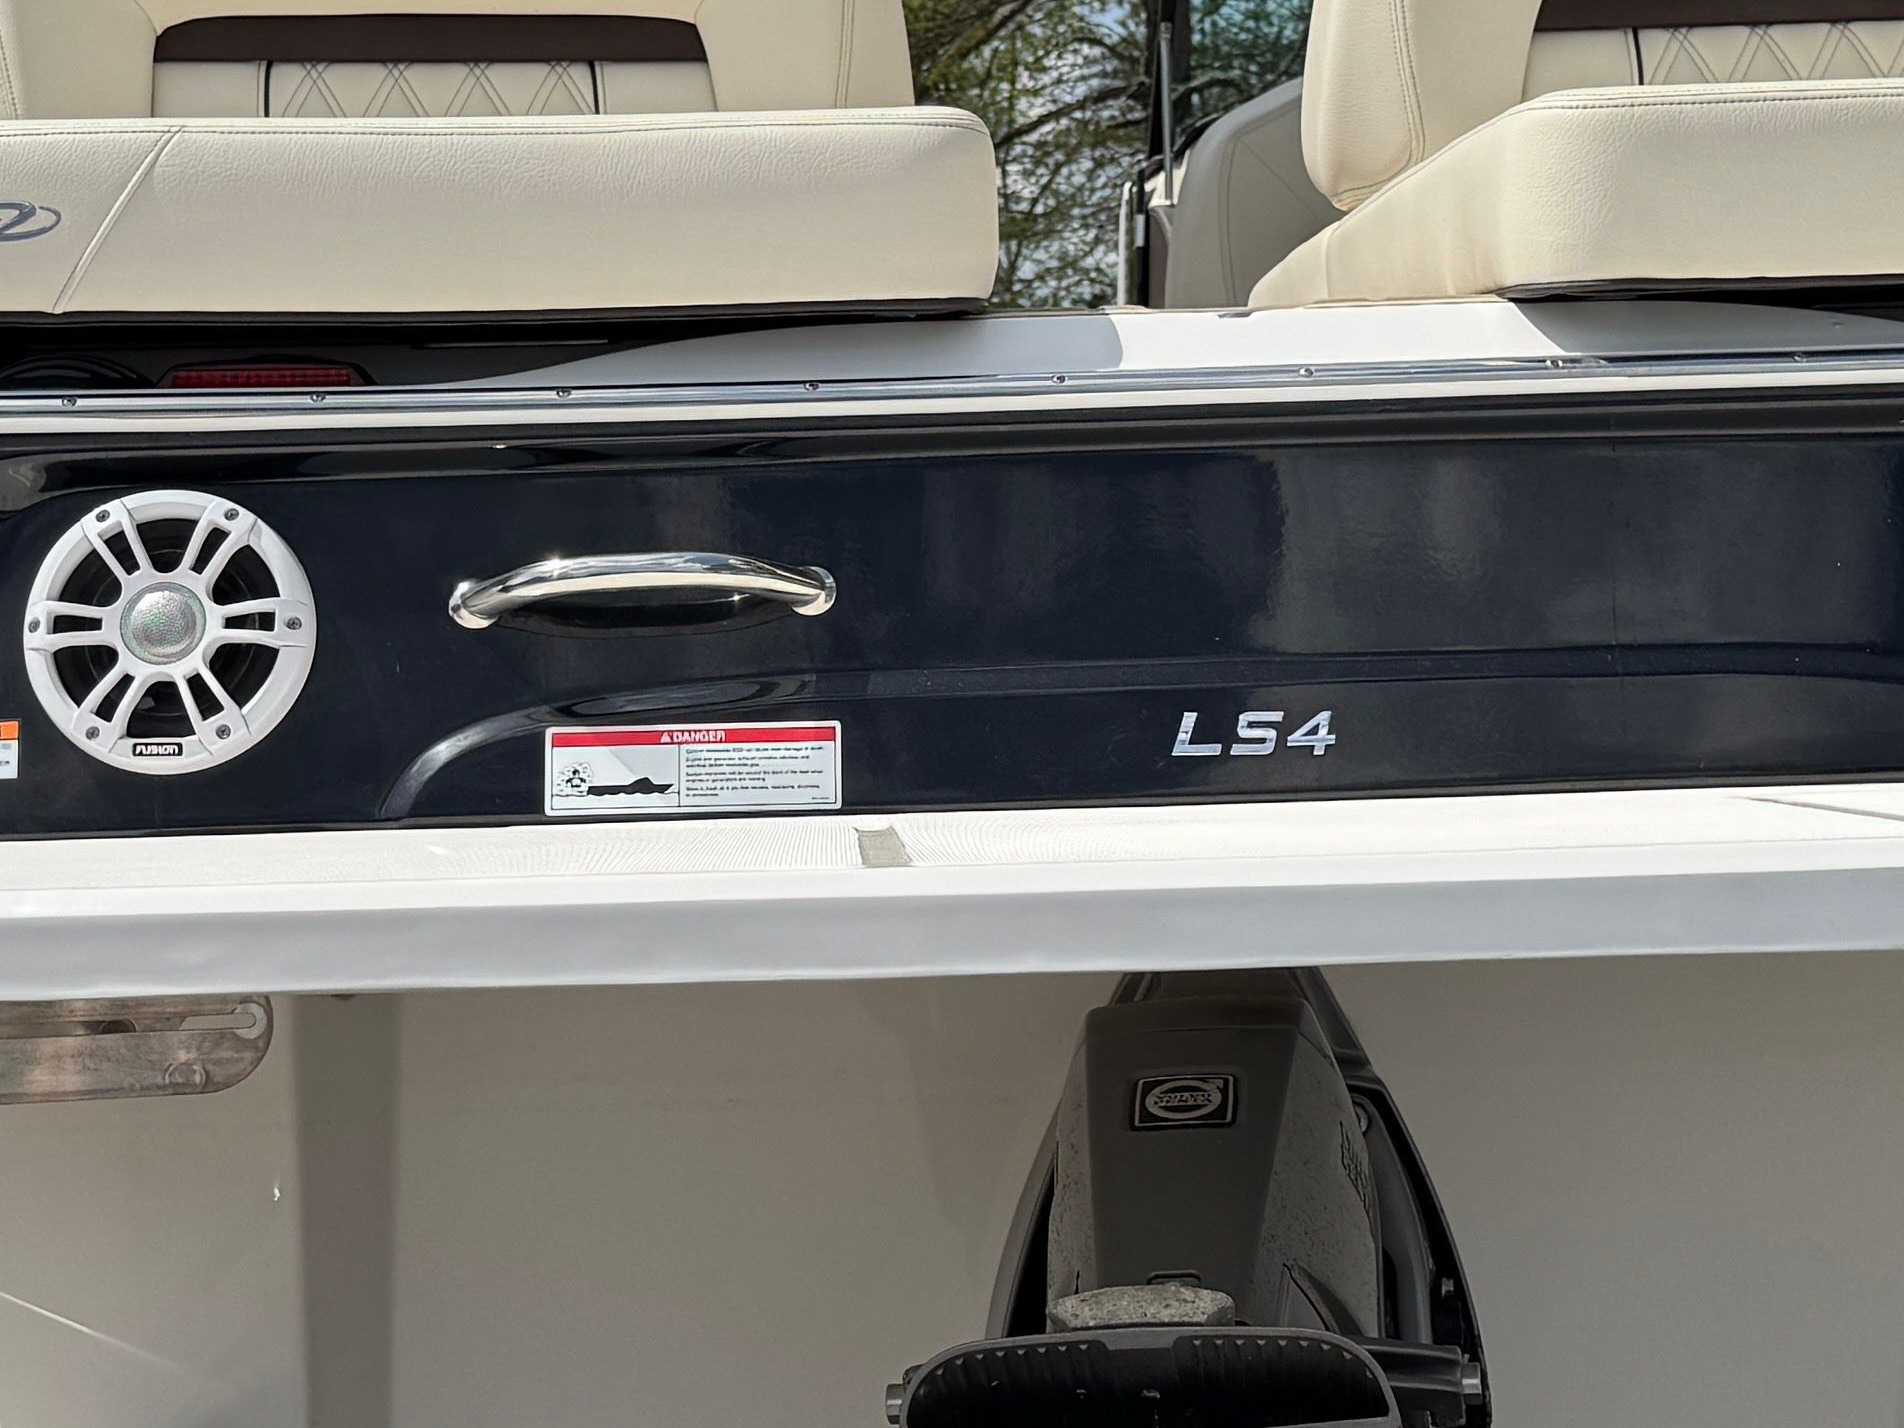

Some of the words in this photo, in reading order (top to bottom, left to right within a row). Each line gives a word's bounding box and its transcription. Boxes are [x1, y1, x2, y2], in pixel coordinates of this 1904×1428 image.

[672, 730, 727, 743] DANGER
[1171, 710, 1338, 757] LS4
[135, 745, 179, 756] FUSION
